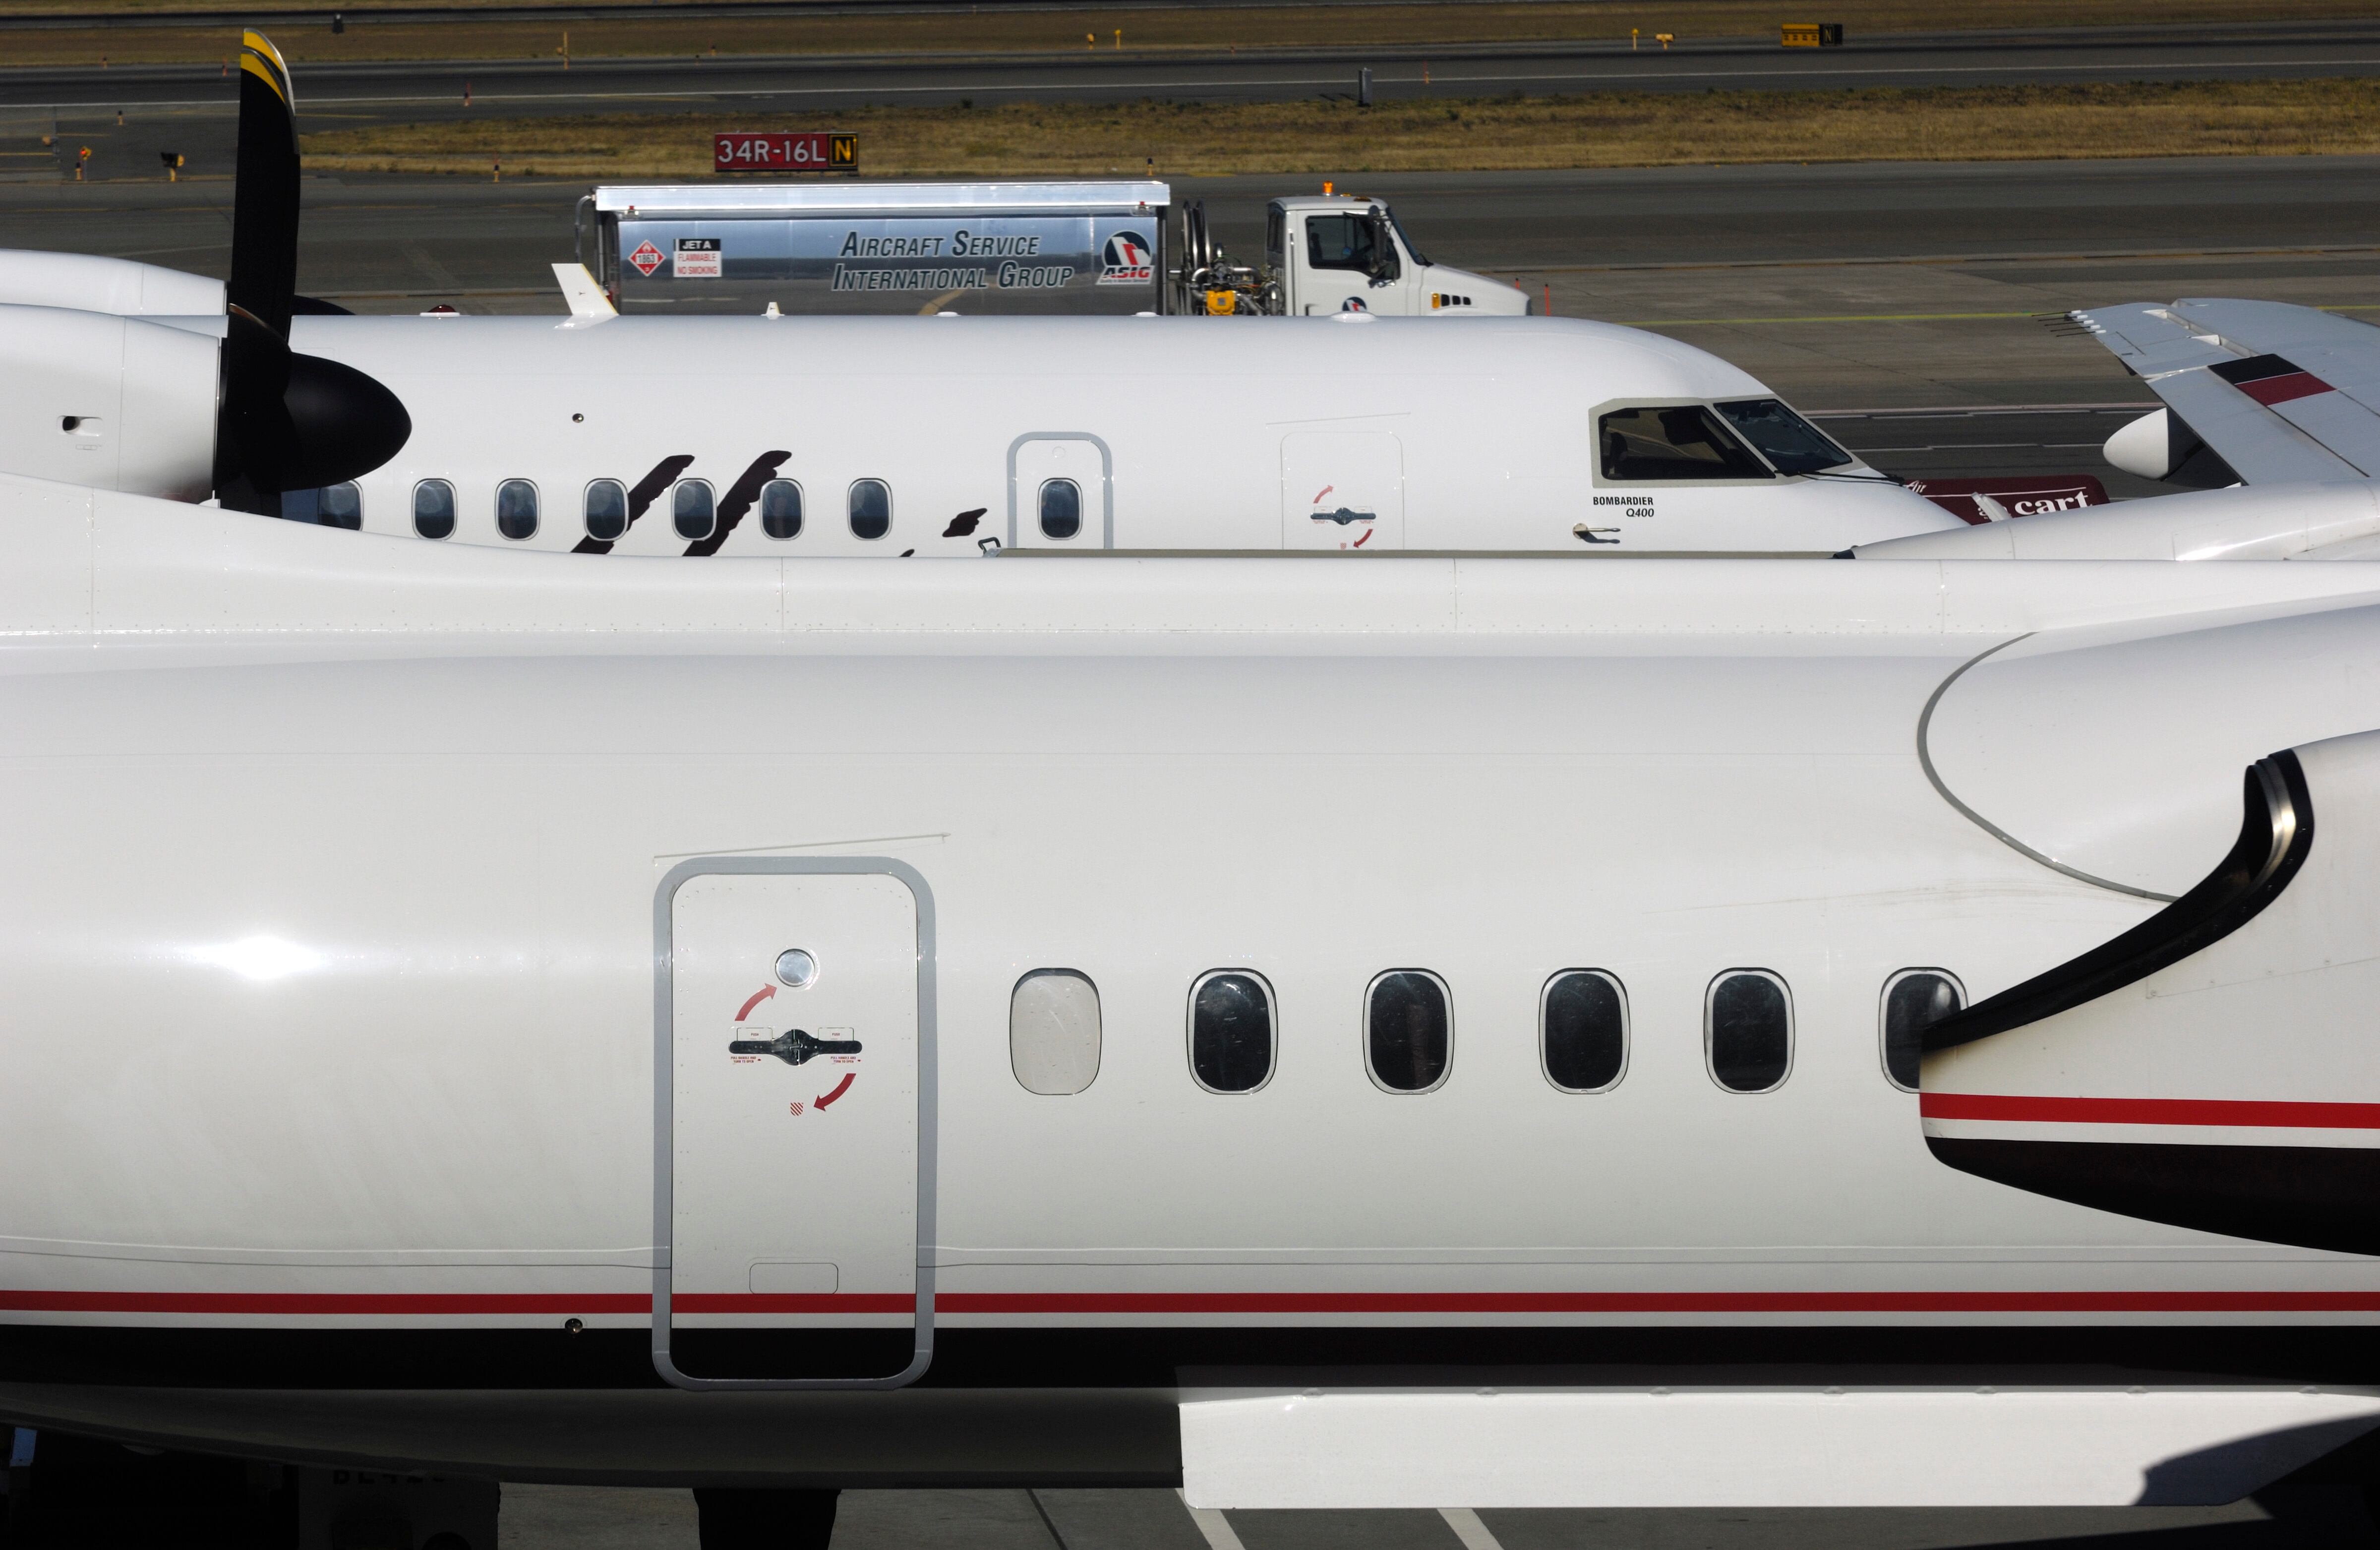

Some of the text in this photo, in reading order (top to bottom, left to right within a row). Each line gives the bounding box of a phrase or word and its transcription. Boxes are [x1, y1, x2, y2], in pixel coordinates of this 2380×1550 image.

[1824, 28, 1832, 42] N
[718, 139, 851, 163] 34R-16L N
[682, 240, 712, 249] JET A
[838, 230, 1040, 257] AIRCRAFT SERVICE
[678, 253, 716, 262] FLAMMABLE
[832, 260, 1075, 291] INTERNATIONAL GROUP
[1102, 267, 1151, 279] ASIG
[1593, 496, 1654, 505] BOMBARDIER
[2014, 491, 2092, 516] cart
[1626, 508, 1655, 517] Q400
